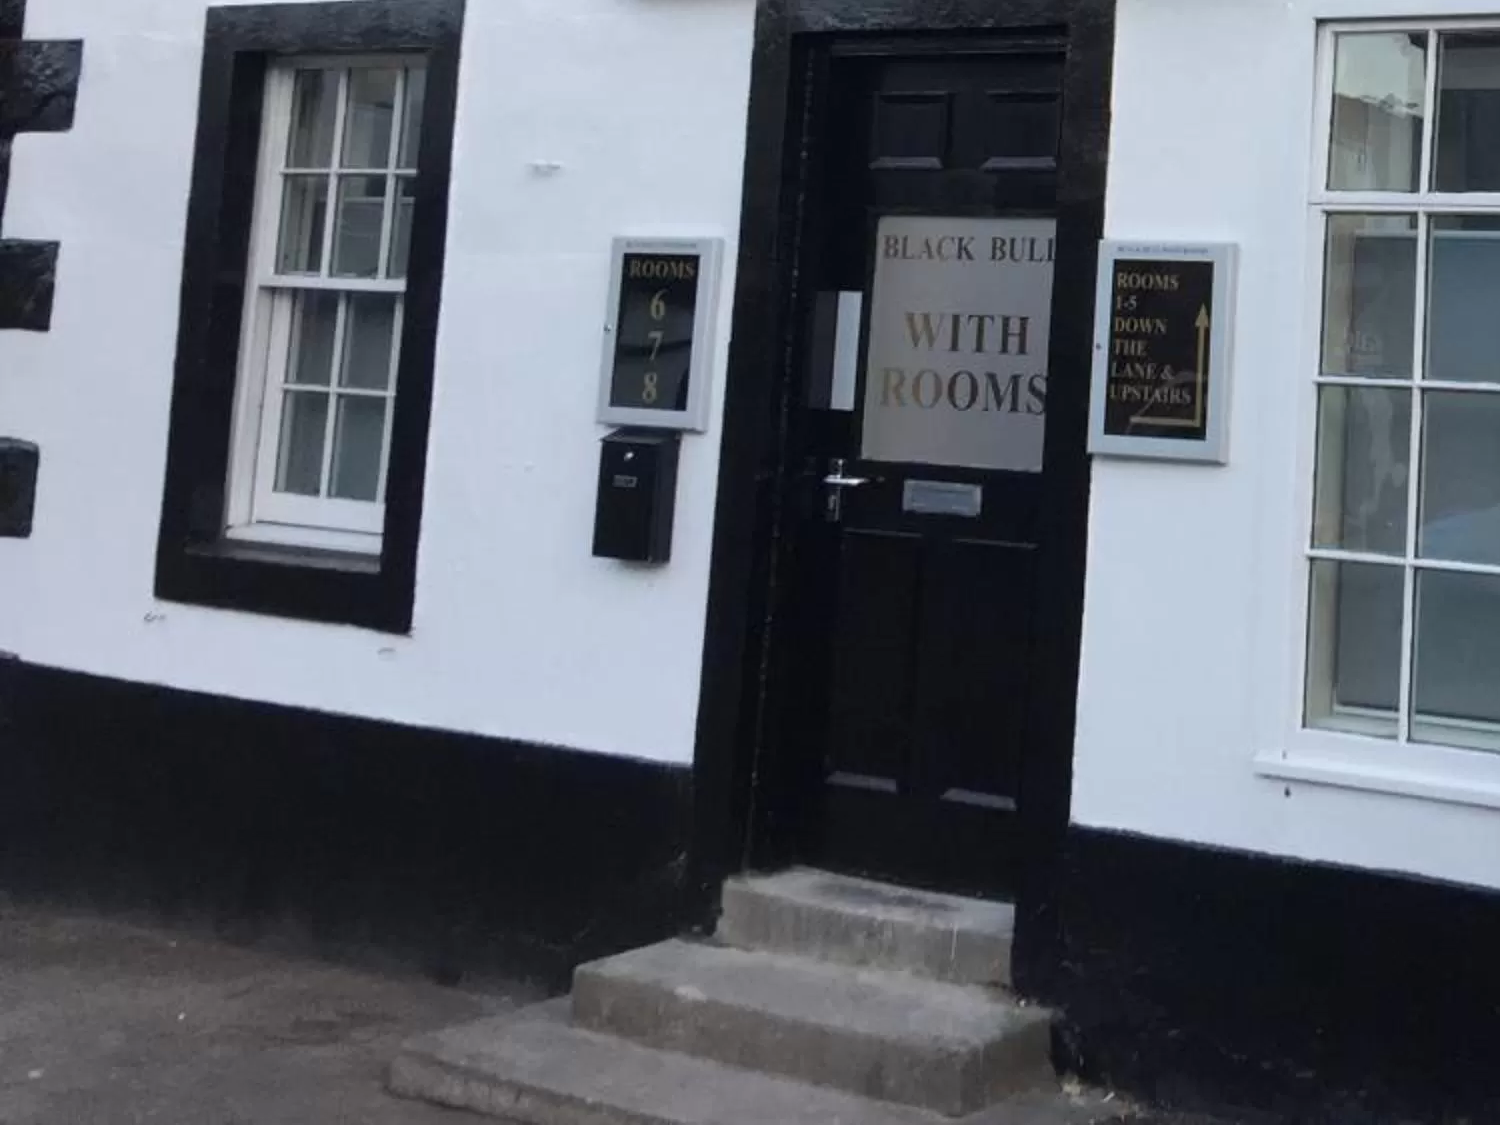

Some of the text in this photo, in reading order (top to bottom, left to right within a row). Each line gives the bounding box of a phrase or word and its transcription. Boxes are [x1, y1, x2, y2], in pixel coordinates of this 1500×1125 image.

[884, 235, 975, 261] BLACK
[630, 259, 695, 279] ROOMS
[1117, 272, 1179, 291] ROOMS
[651, 288, 669, 321] 6
[1117, 295, 1137, 311] 1-5
[904, 311, 1031, 356] WITH
[1115, 318, 1167, 334] DOWN
[648, 330, 664, 361] 7
[1114, 338, 1147, 356] THE
[1111, 362, 1175, 380] LANE &
[643, 373, 657, 404] 8
[879, 367, 1048, 416] ROOMS
[1110, 385, 1192, 405] UPSTAIRS
